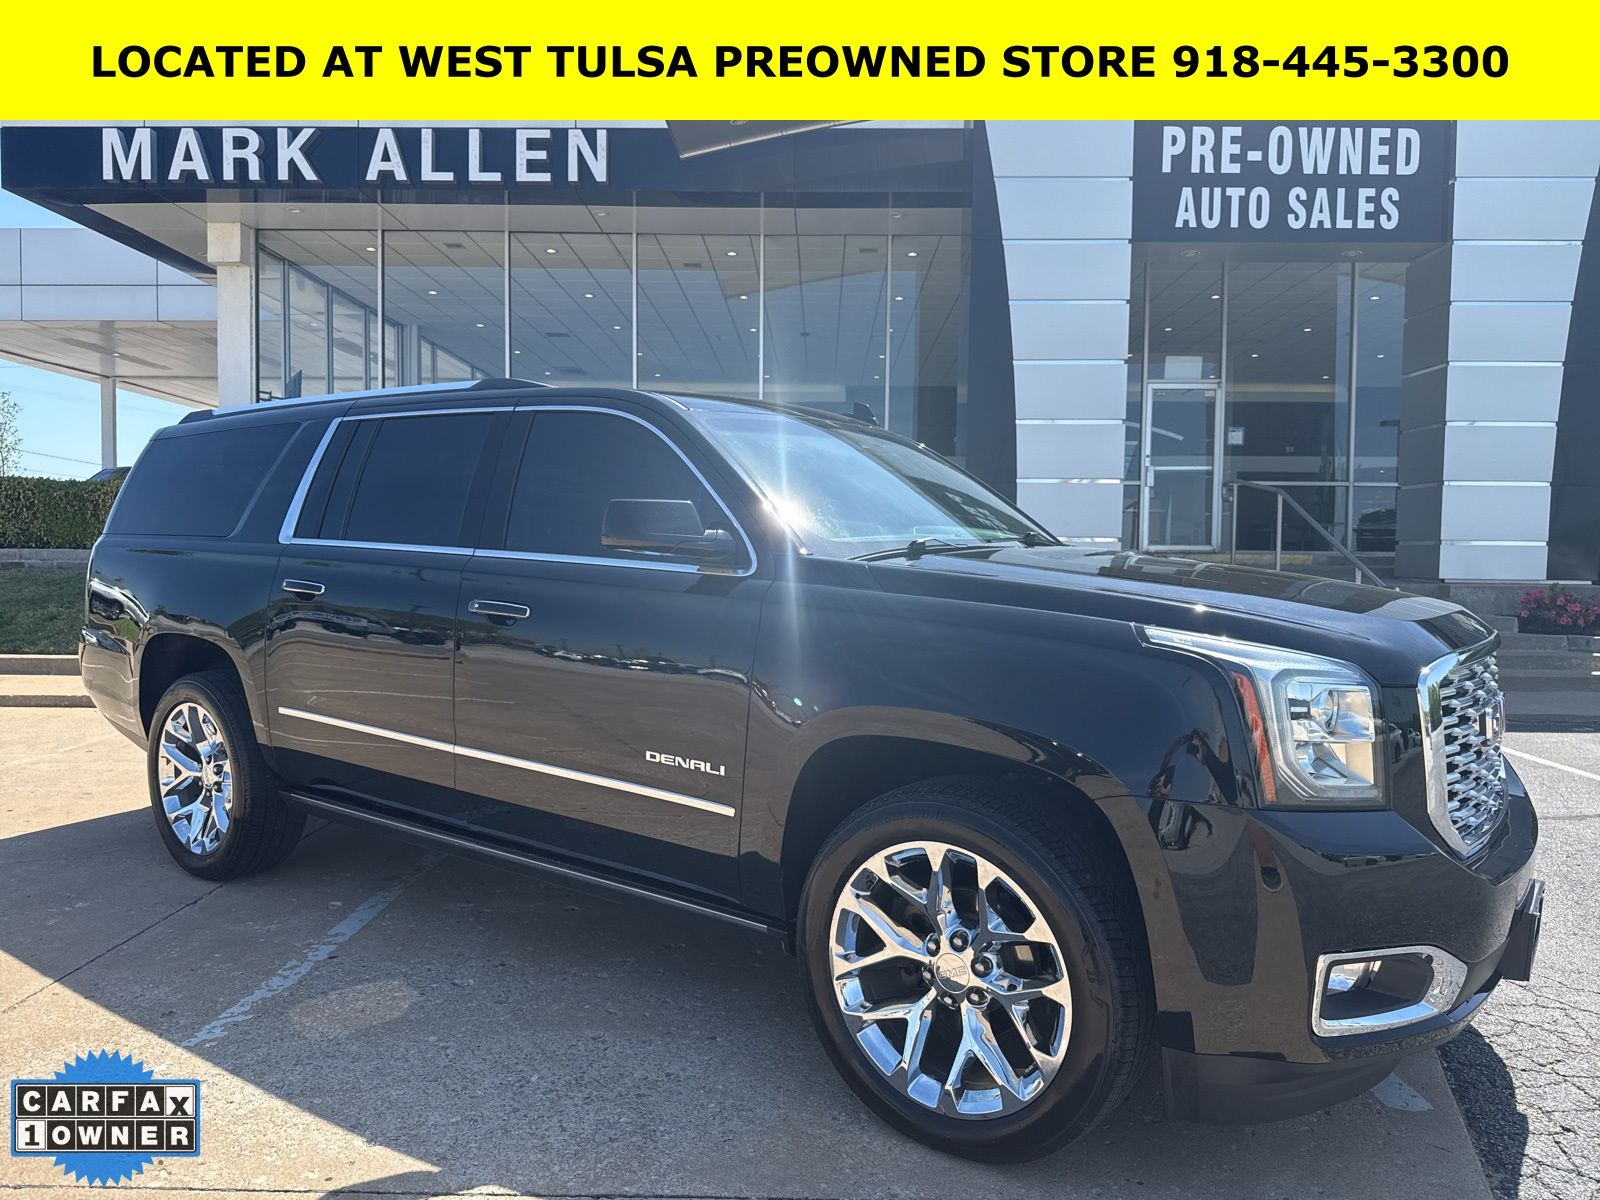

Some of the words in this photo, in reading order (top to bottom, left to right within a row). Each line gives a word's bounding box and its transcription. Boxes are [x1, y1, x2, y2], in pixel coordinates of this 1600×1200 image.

[102, 127, 319, 182] MARK
[365, 128, 608, 183] ALLEN
[1161, 125, 1421, 176] PRE-OWNED
[1174, 186, 1270, 229] AUTO
[1287, 186, 1400, 230] SALES
[645, 750, 726, 776] DENALI
